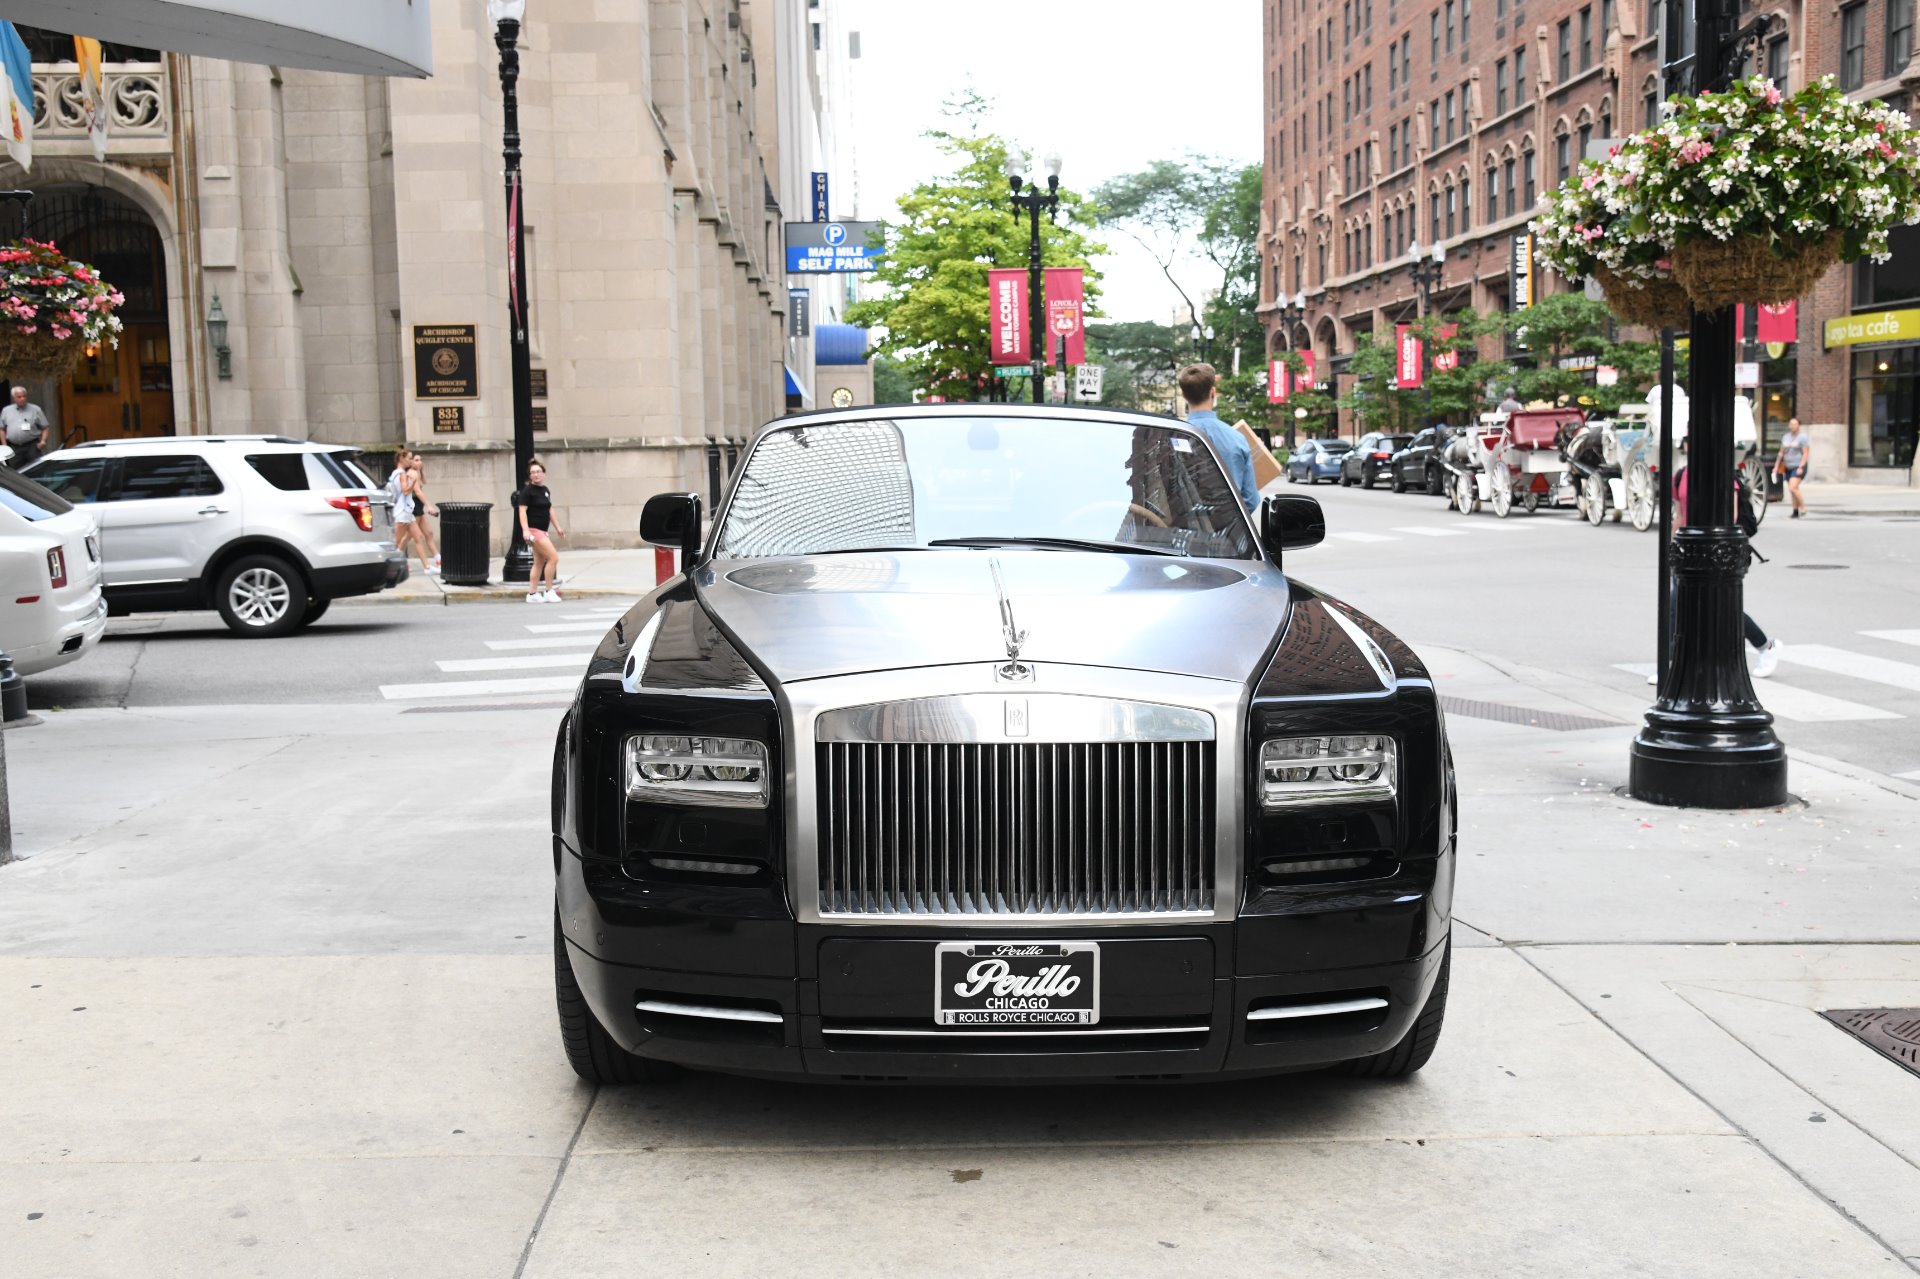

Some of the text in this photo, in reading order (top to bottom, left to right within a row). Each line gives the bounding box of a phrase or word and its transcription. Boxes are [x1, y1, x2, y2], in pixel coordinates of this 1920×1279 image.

[817, 174, 826, 222] GHIRA
[808, 246, 864, 257] MAG MILE
[1516, 236, 1528, 274] BAGELS
[798, 257, 874, 270] SELF PARK
[999, 280, 1013, 354] WELCOME
[1866, 313, 1900, 335] café
[416, 336, 473, 345] QUIGLEY CENTER
[1079, 368, 1099, 378] ONE
[1079, 379, 1099, 387] WAY
[438, 408, 459, 419] 835
[991, 945, 1044, 956] Perillo
[954, 958, 1081, 998] Perillo
[985, 997, 1049, 1009] CHICAGO
[959, 1012, 990, 1023] ROLLS
[992, 1012, 1027, 1022] ROYCE
[1029, 1012, 1075, 1022] CHICAGO
